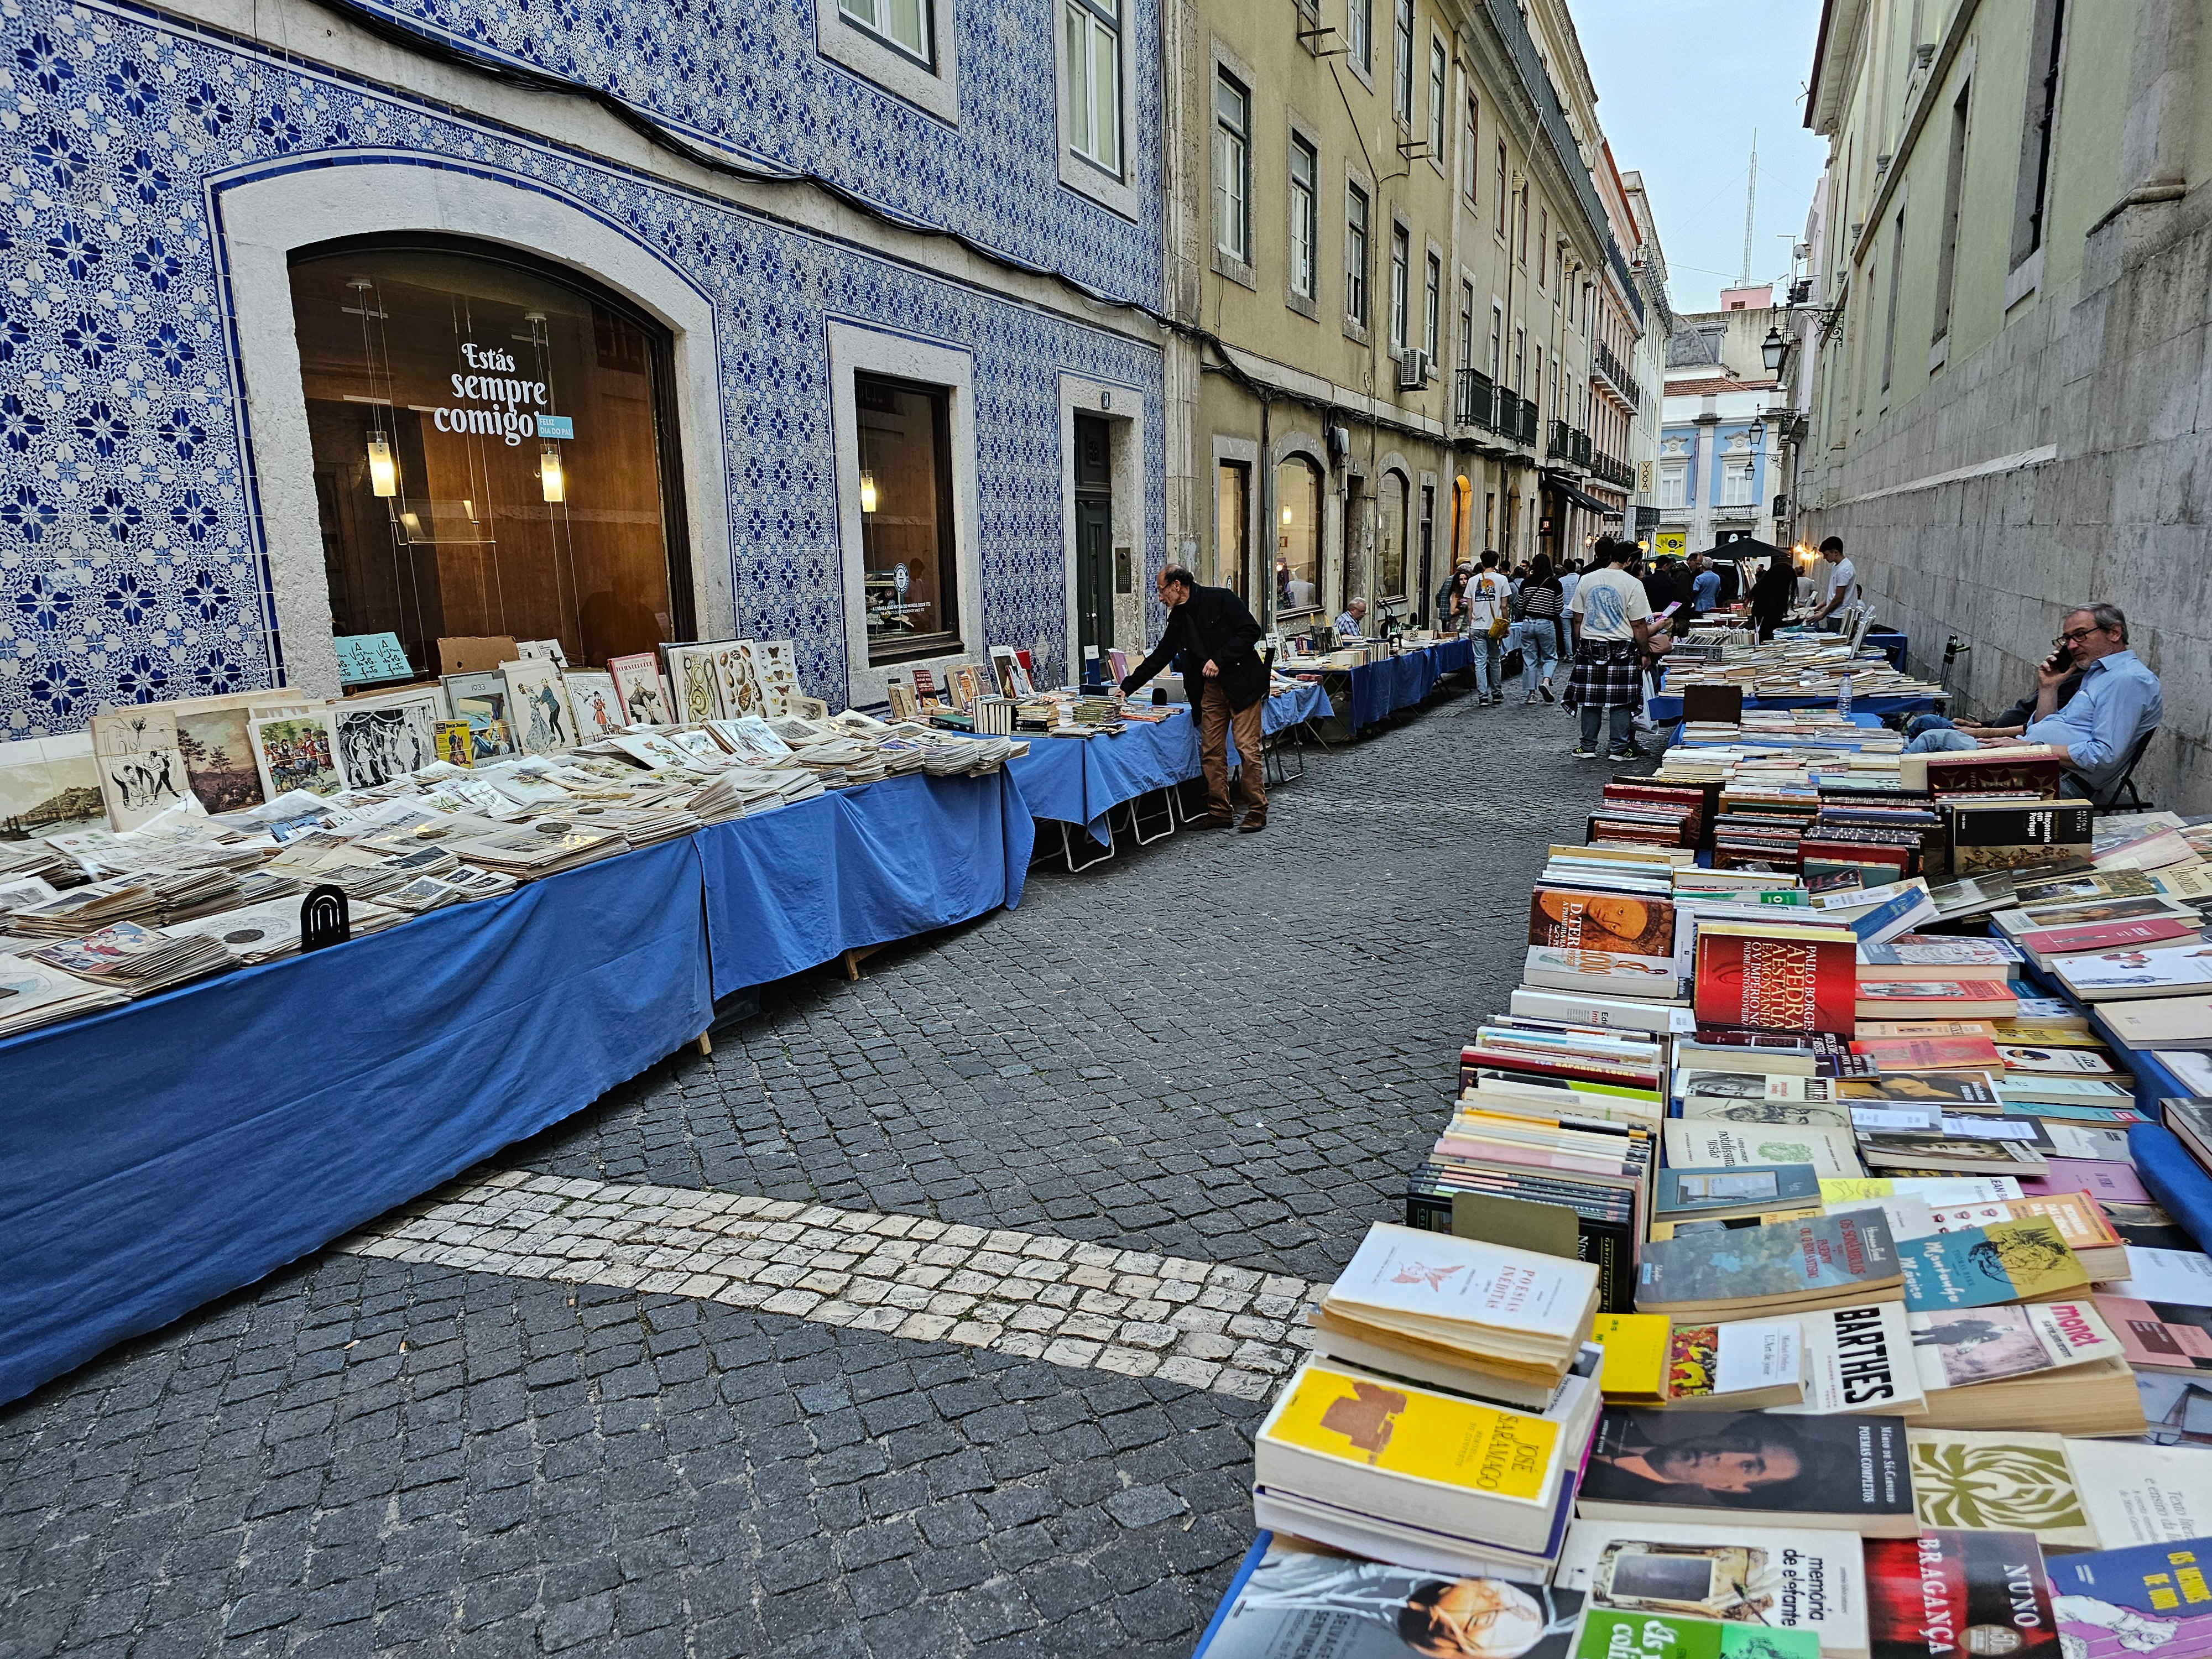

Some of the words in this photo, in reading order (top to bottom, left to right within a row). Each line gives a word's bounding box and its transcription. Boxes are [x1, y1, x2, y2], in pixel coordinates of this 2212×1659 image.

[461, 343, 515, 372] Estás
[451, 373, 547, 412] sempre
[1642, 462, 1651, 490] YOGA
[471, 684, 486, 692] 1933
[2027, 812, 2037, 837] Portugal
[2037, 812, 2043, 822] em
[2043, 812, 2052, 843] Maçonaria
[1560, 907, 1569, 938] PRIMEIRA
[1751, 942, 1762, 951] O
[1751, 952, 1761, 961] V
[1772, 943, 1787, 954] A
[1787, 944, 1805, 958] A
[1805, 945, 1817, 984] PAULO
[1760, 961, 1772, 1027] MONTANHA
[1785, 962, 1804, 1029] PEDRA
[1803, 987, 1816, 1031] BORGES
[1804, 1083, 1828, 1100] MILLER
[1989, 1178, 2006, 1192] JEAN
[1486, 1265, 1516, 1308] INÉDITAS
[1505, 1269, 1536, 1312] POESIAS
[2048, 1305, 2108, 1348] monet
[1834, 1307, 1894, 1404] BARTHES
[1477, 1413, 1519, 1488] SARAMAGO
[1511, 1439, 1540, 1474] JOSÉ
[1858, 1426, 1871, 1456] POEMAS
[1860, 1457, 1875, 1503] COMPLETOS
[1782, 1549, 1806, 1566] de
[1781, 1569, 1806, 1626] elefante
[1808, 1557, 1833, 1621] memória
[1917, 1538, 1955, 1655] BRAGANÇA
[2002, 1564, 2041, 1627] NUNO
